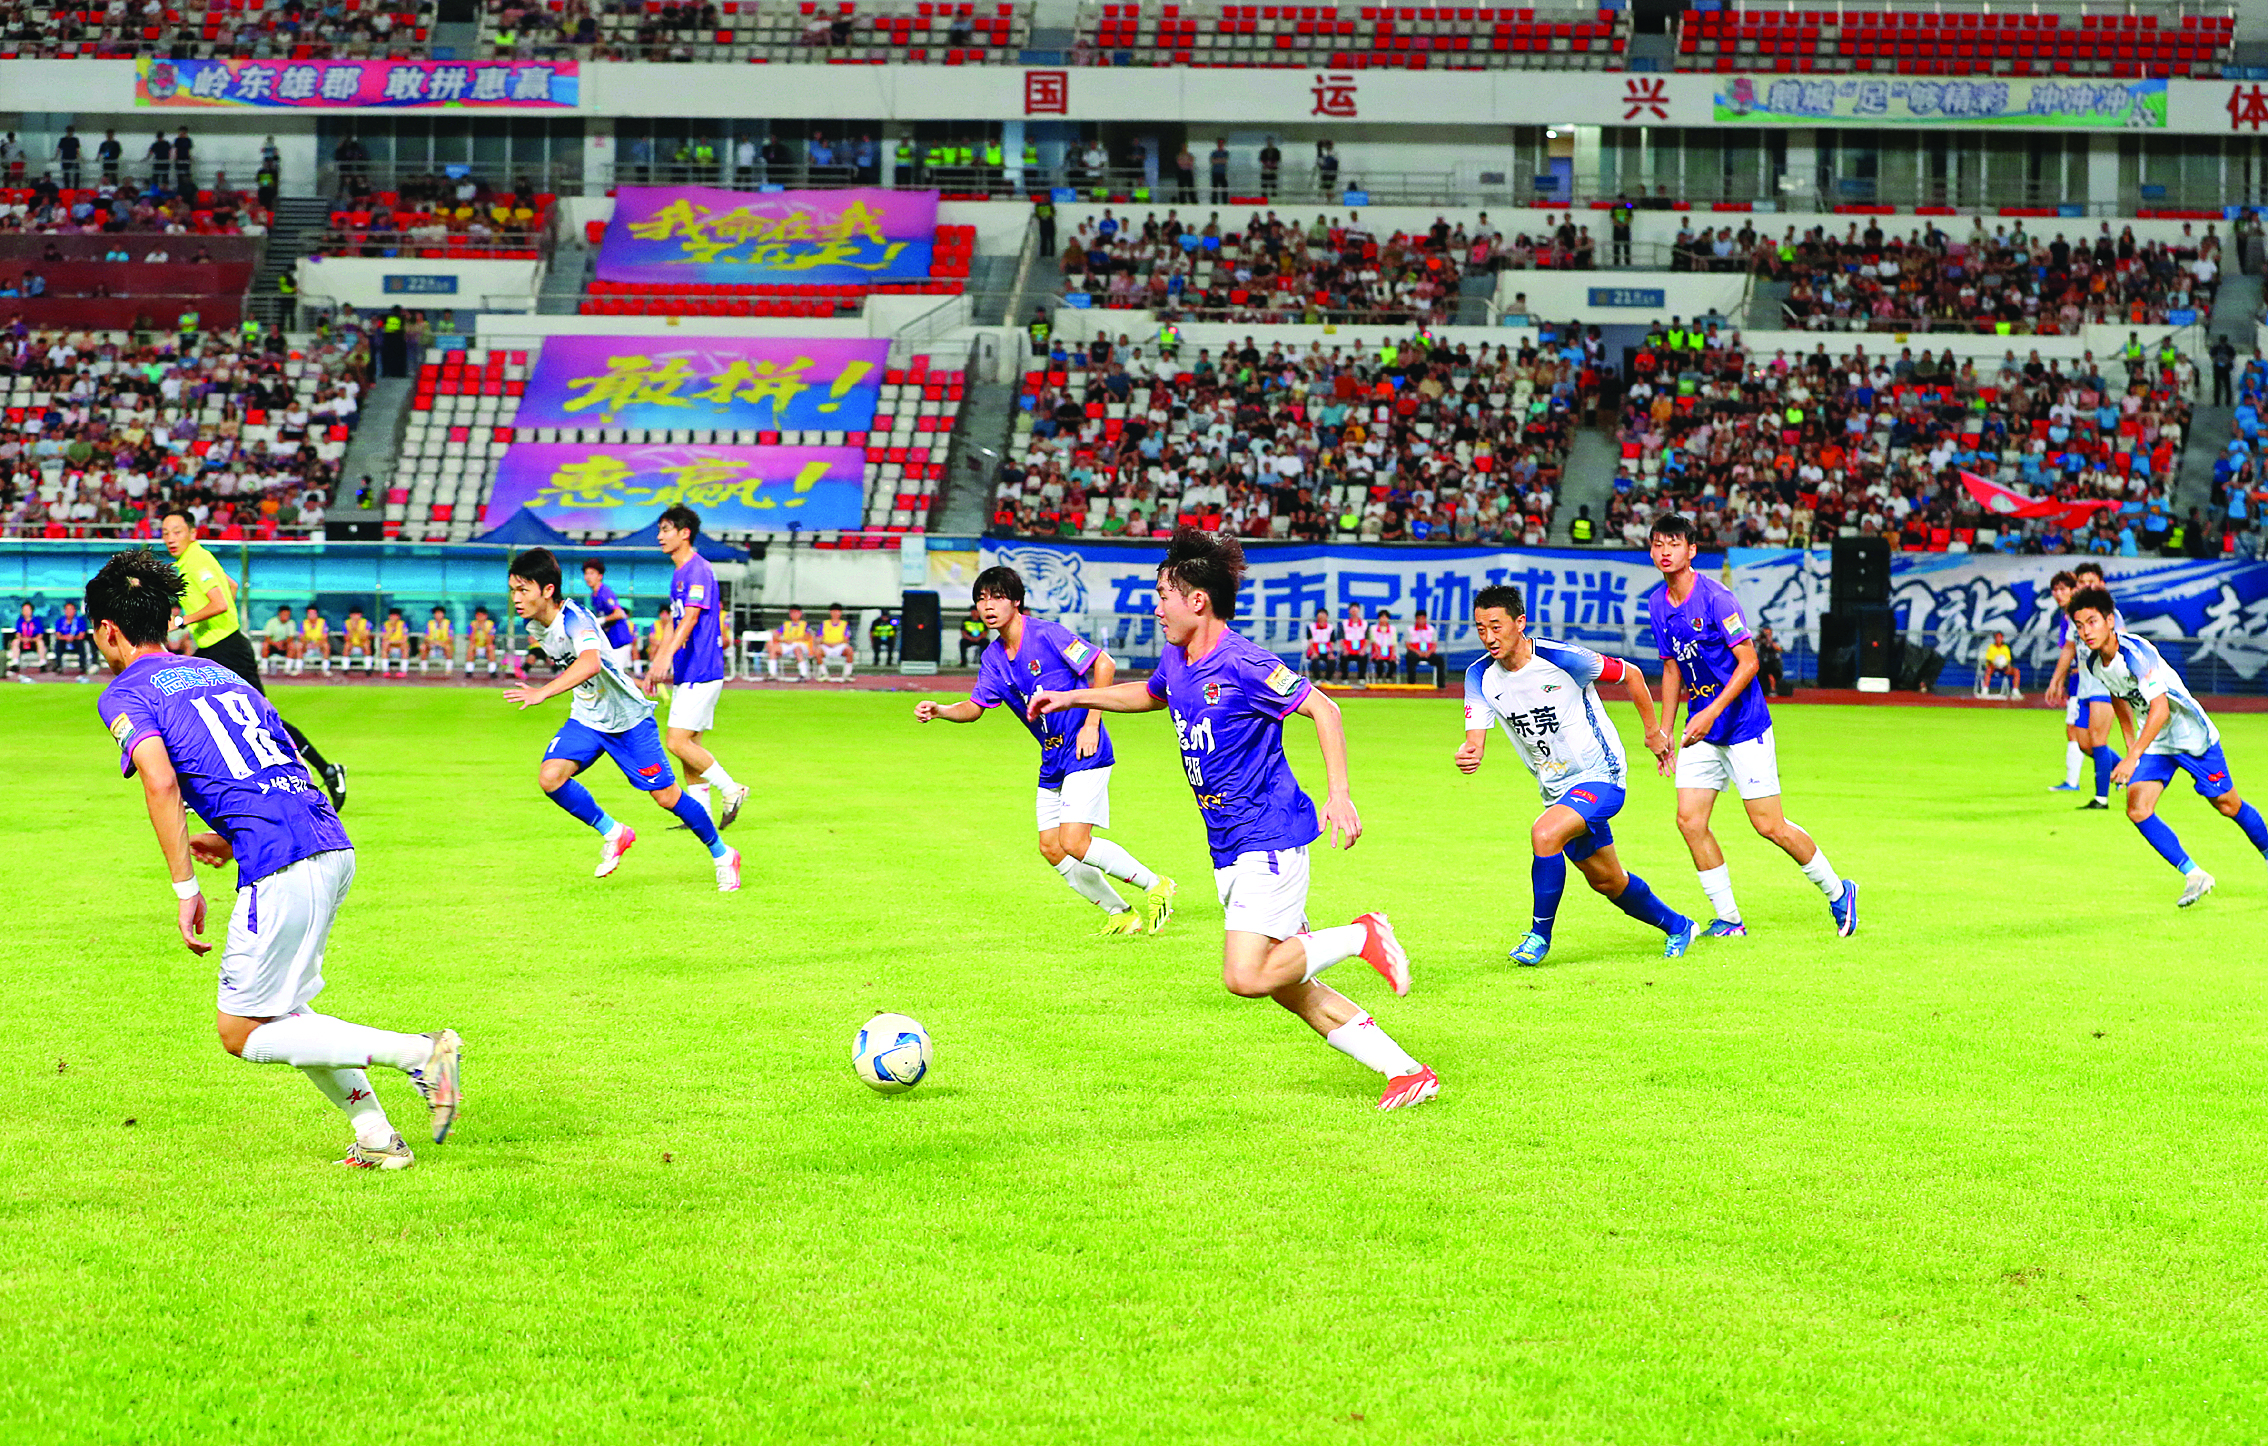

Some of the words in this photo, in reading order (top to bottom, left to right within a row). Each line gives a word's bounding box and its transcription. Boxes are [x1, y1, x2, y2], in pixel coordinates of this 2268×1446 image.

[191, 65, 363, 99] 岭东雄郡
[383, 65, 556, 101] 敢拼惠赢
[1025, 70, 1069, 115] 国
[1310, 74, 1357, 117] 运
[1623, 77, 1669, 119] 兴
[2226, 84, 2268, 131] 体
[189, 690, 295, 781] 18
[1506, 705, 1560, 738] 东莞
[1535, 739, 1551, 757] 6
[1183, 755, 1205, 787] 26
